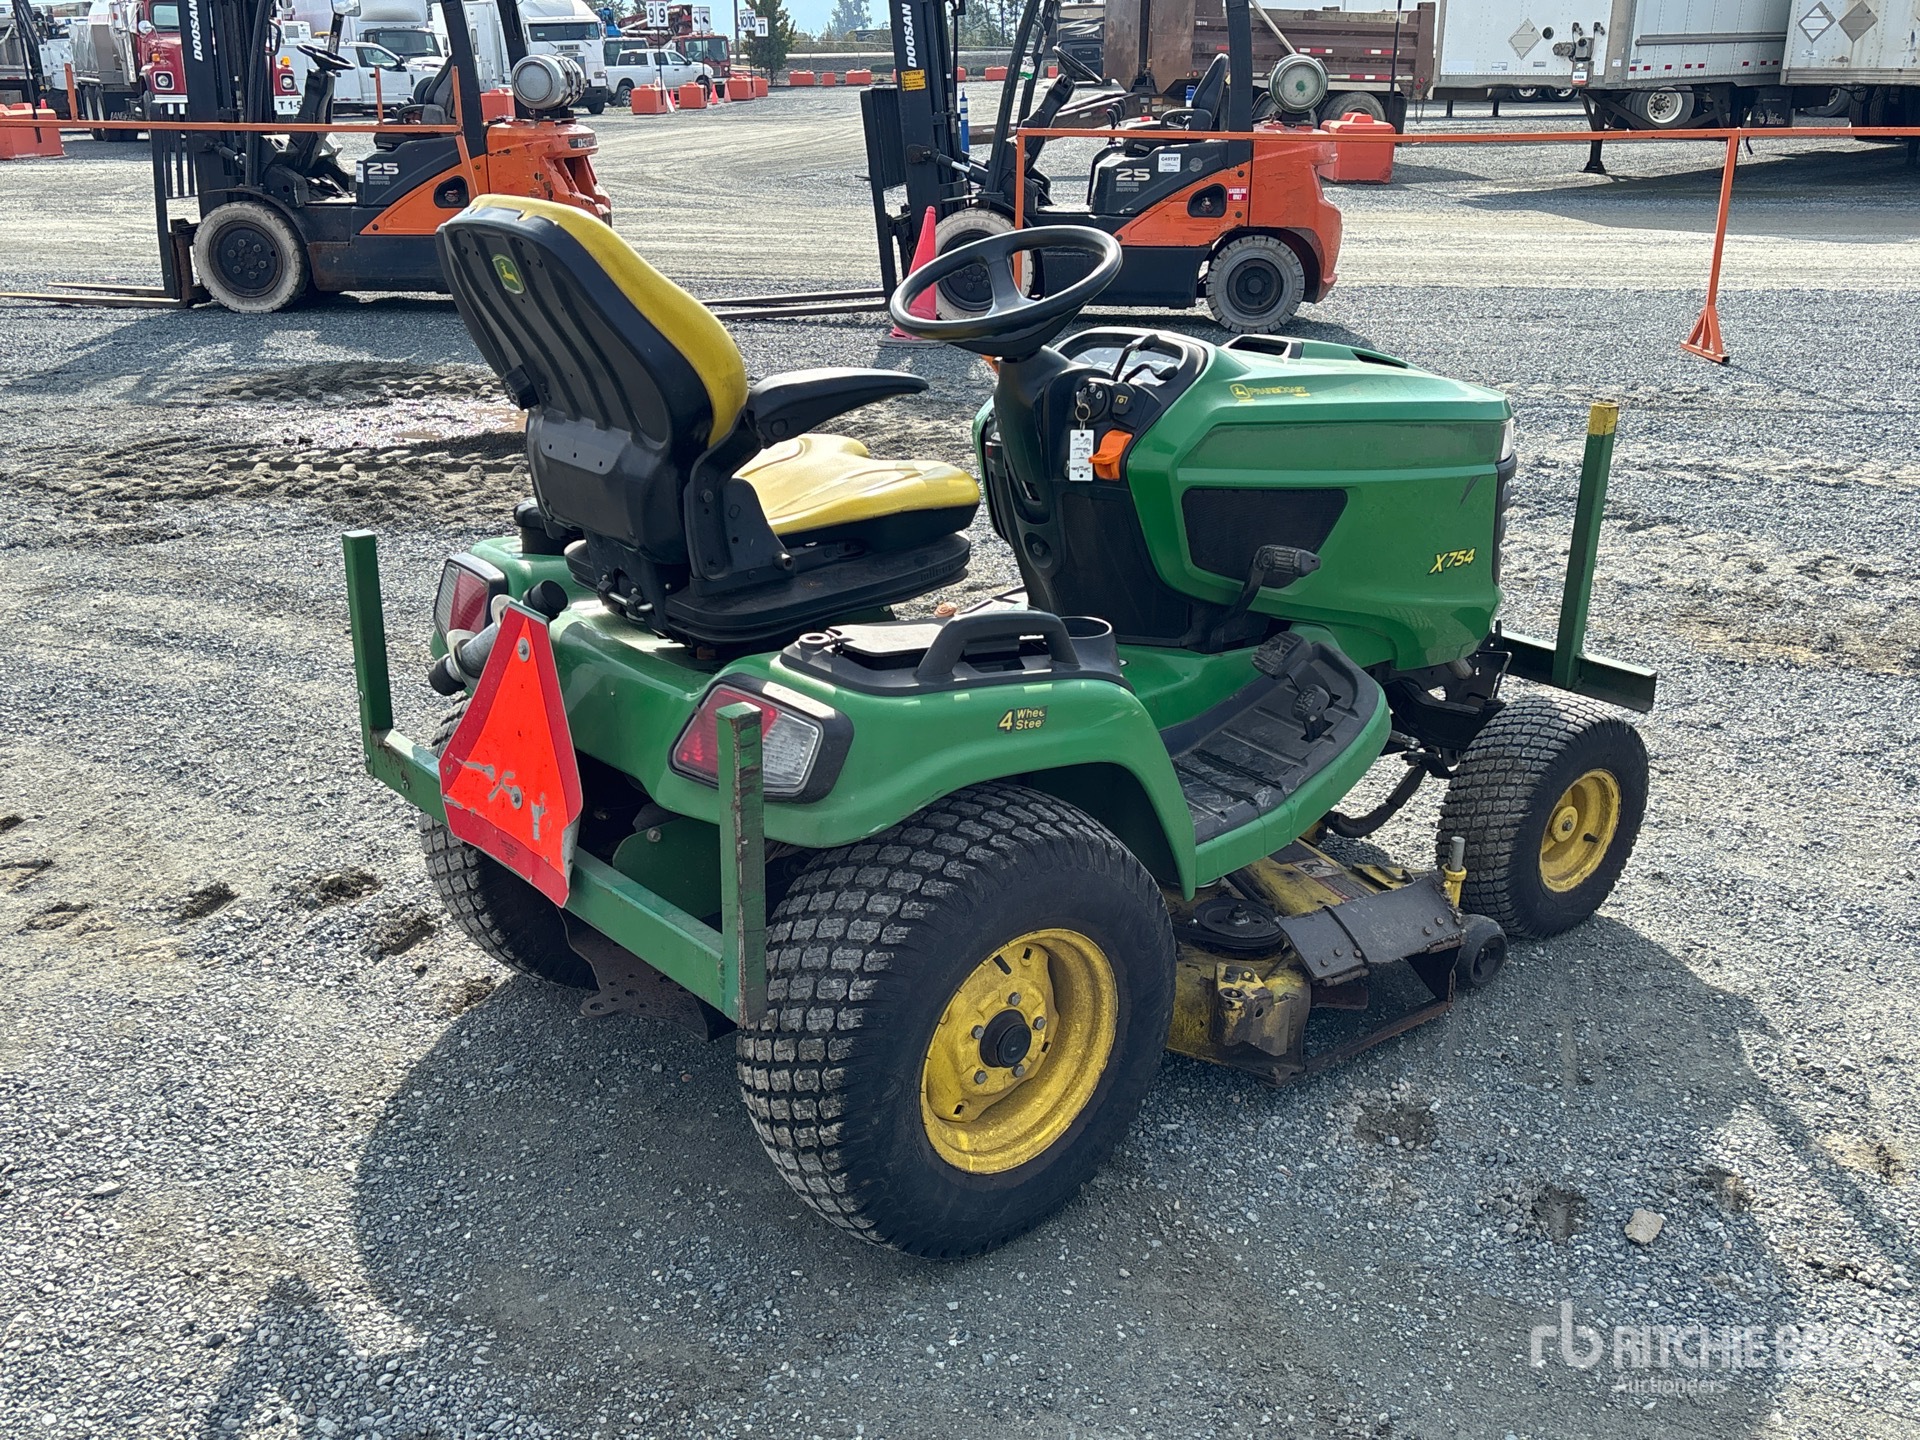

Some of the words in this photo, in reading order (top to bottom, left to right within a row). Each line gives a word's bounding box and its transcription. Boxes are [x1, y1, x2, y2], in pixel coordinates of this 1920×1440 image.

[648, 8, 655, 23] 9
[659, 8, 666, 23] 9
[740, 16, 747, 28] 10
[747, 15, 756, 28] 10
[189, 0, 203, 61] DOOSAN
[758, 24, 766, 34] 11
[902, 3, 917, 68] DOOSAN
[278, 101, 285, 110] T
[367, 163, 399, 174] 25
[1116, 168, 1151, 181] 25
[1429, 548, 1476, 573] X754
[999, 711, 1013, 730] 4
[1016, 709, 1045, 719] Whee
[1015, 719, 1044, 730] Stee
